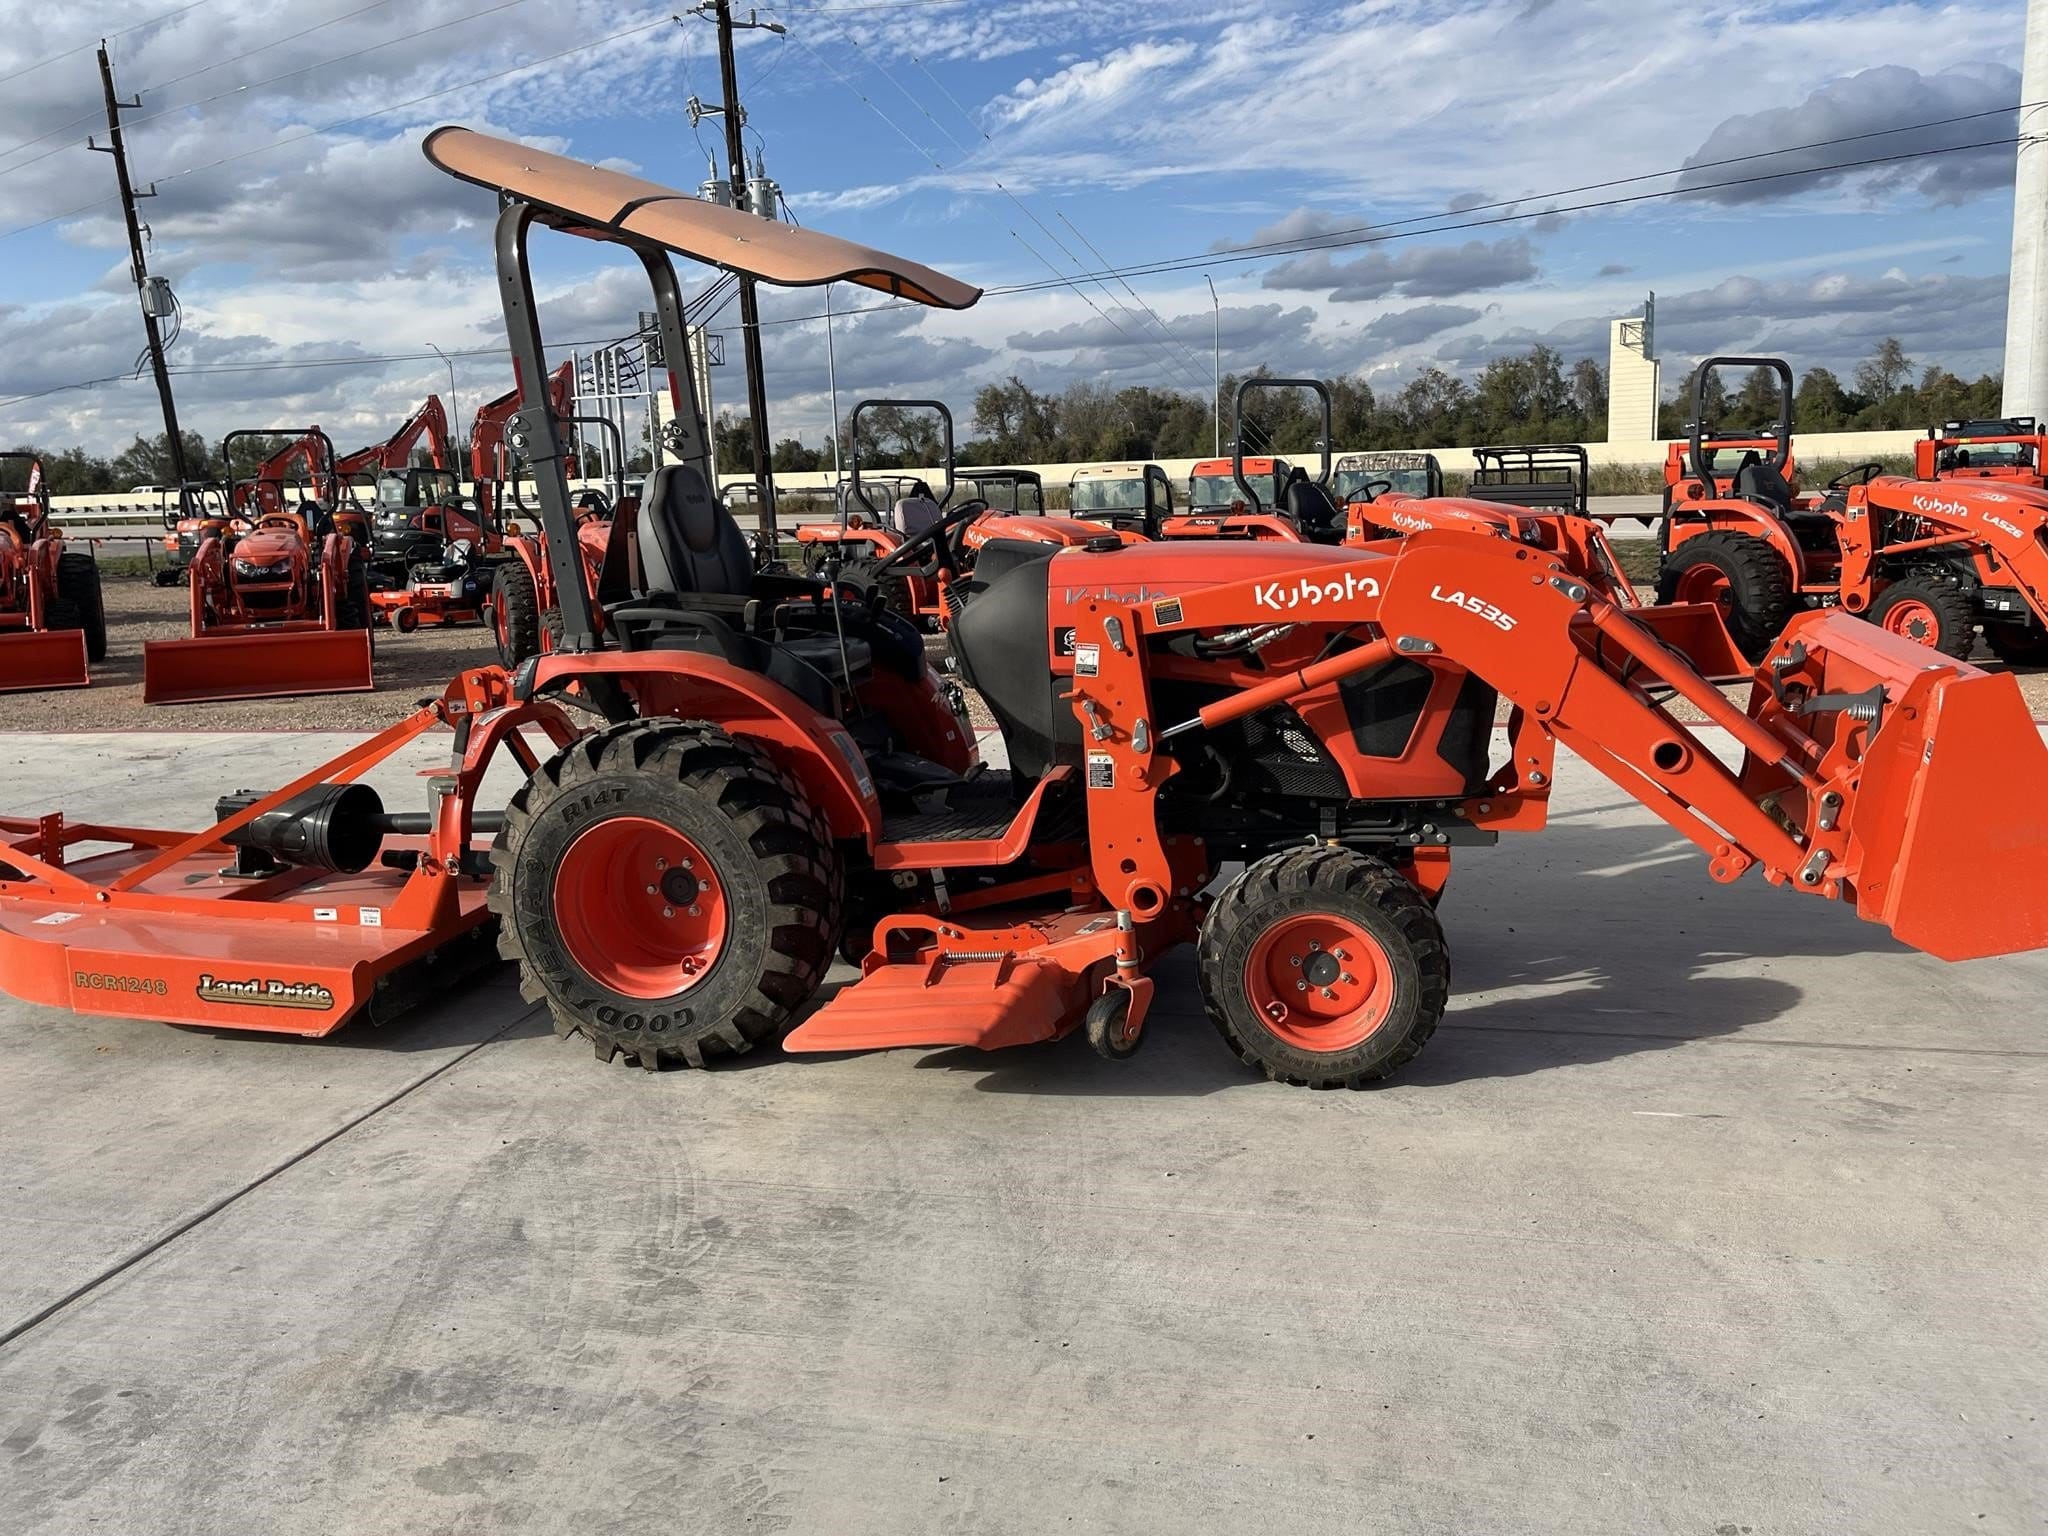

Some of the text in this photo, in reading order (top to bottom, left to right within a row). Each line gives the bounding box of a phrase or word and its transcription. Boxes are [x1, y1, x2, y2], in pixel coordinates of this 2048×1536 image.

[1912, 495, 1968, 517] Kubota
[1391, 511, 1433, 531] Kubota
[1982, 511, 2025, 539] LA526
[1254, 572, 1380, 610] Kubota
[1431, 585, 1518, 631] LA535
[561, 787, 630, 826] R14T
[74, 971, 168, 995] RCR1248
[200, 975, 332, 1002] Land Pride
